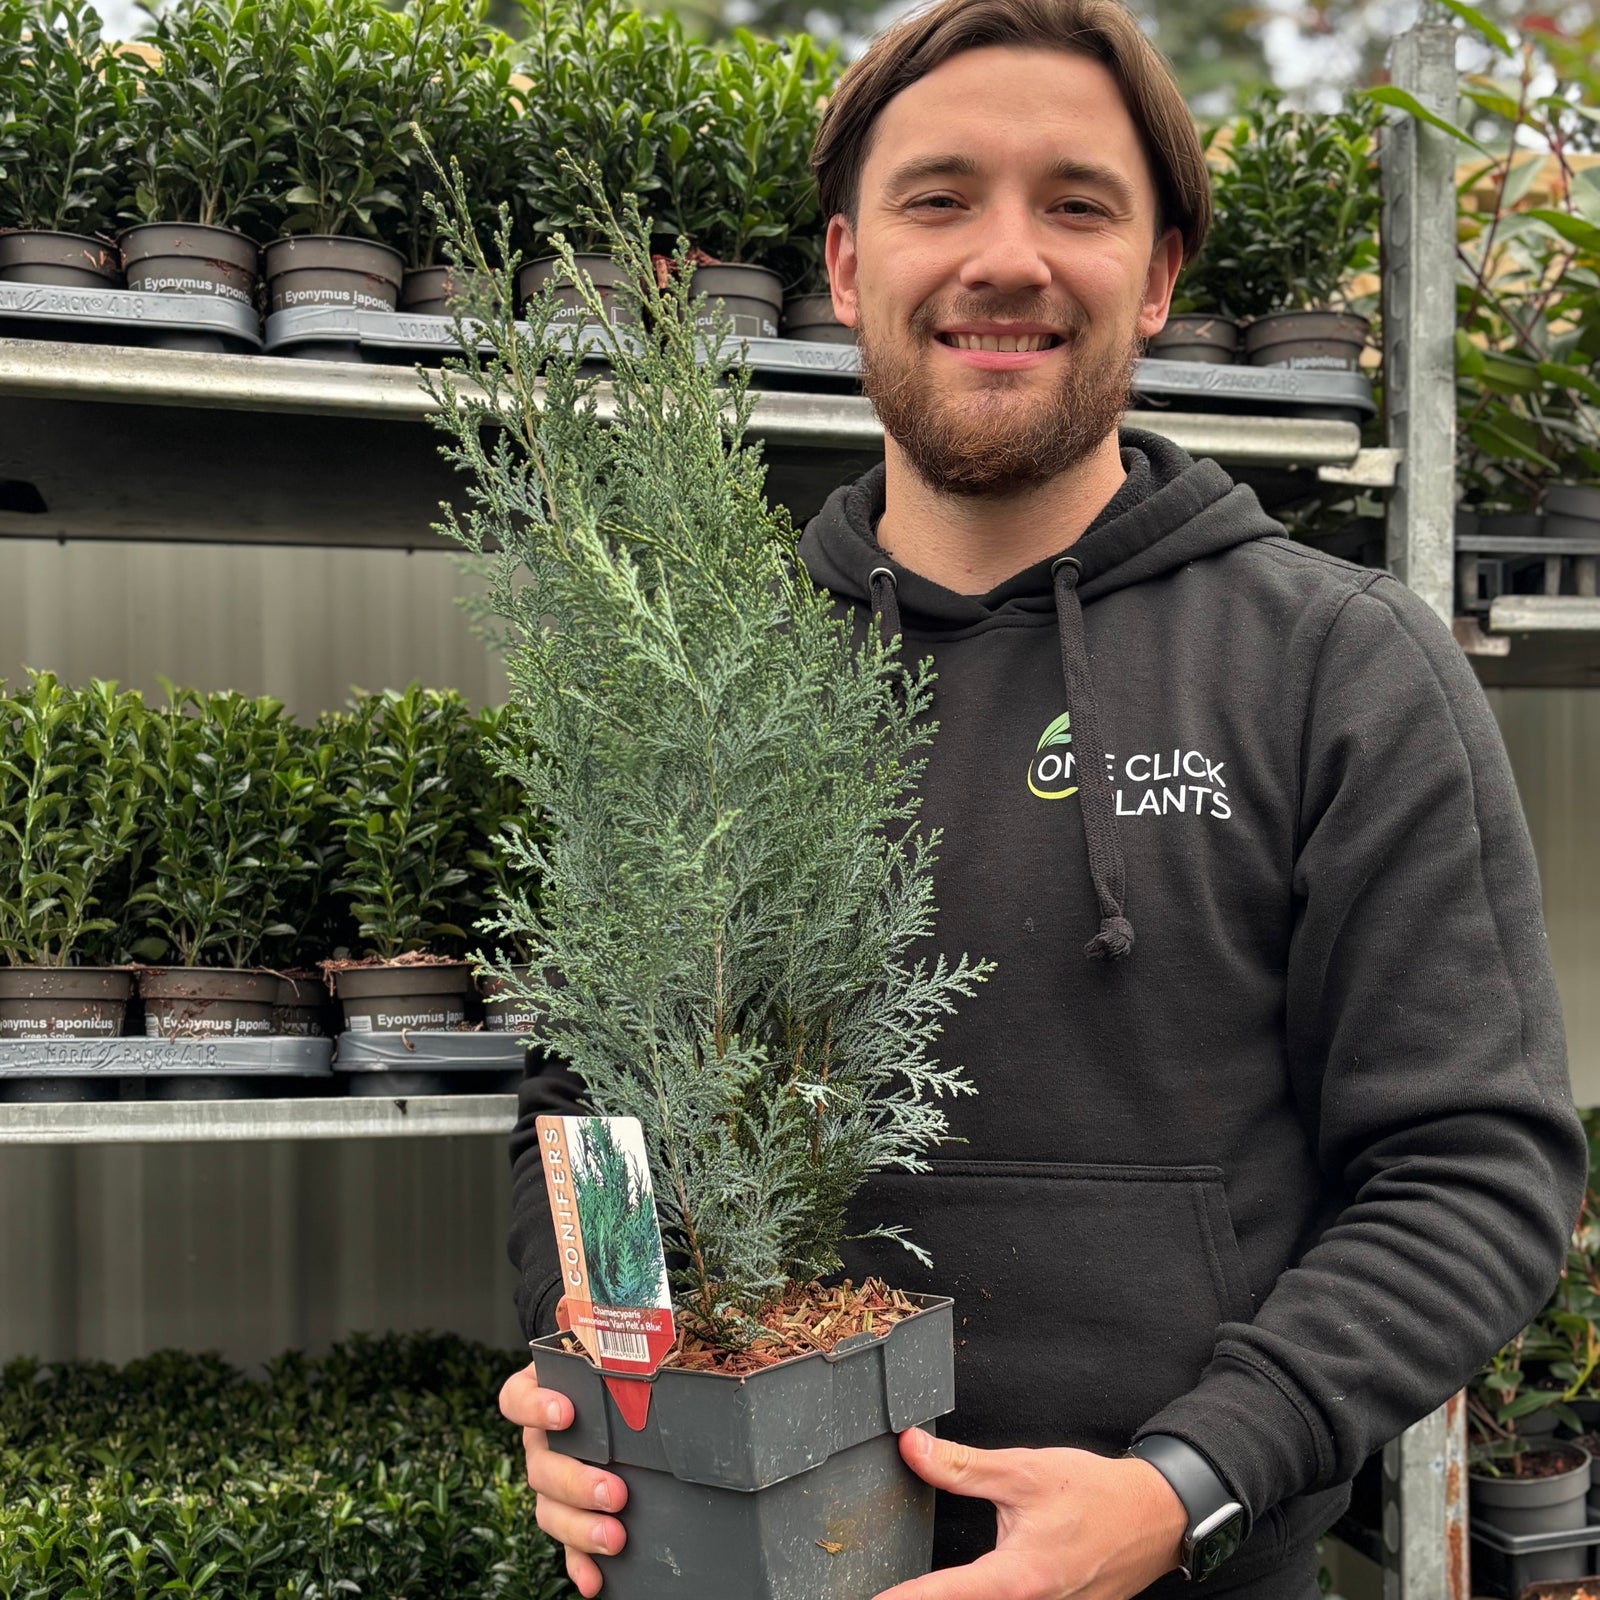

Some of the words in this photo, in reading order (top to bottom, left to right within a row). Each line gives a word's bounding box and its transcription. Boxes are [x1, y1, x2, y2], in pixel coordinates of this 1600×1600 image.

[284, 289, 350, 304] Eyonymus
[1125, 749, 1227, 788] CLICK
[1111, 784, 1232, 820] LANTS
[377, 1013, 444, 1028] Eyonymus
[544, 1128, 582, 1287] CONIFERS
